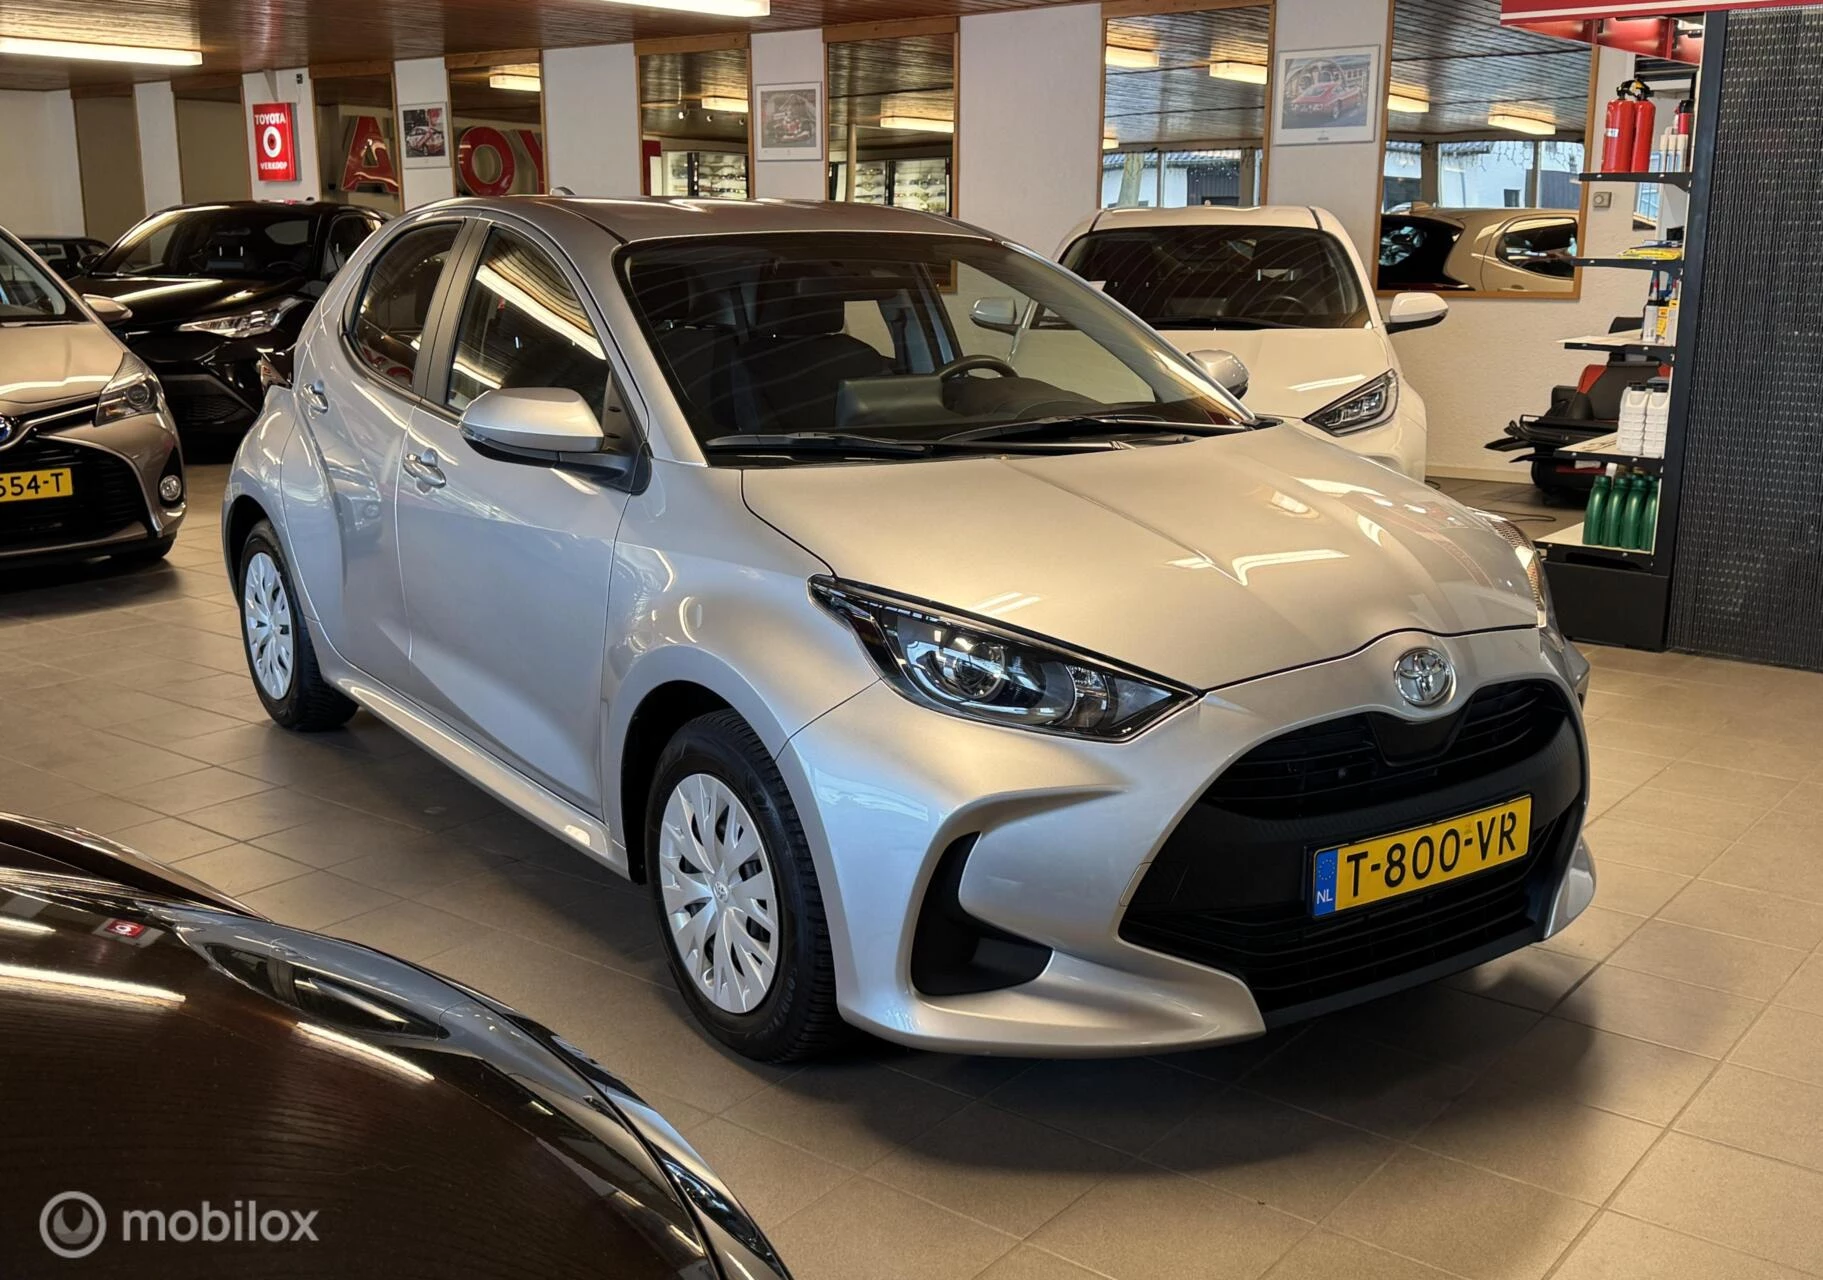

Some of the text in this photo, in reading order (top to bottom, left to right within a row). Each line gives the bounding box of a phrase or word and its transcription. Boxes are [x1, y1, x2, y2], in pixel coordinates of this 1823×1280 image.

[255, 112, 287, 125] TOYOTA
[1346, 811, 1517, 897] T-800-VR
[1316, 887, 1333, 904] NL
